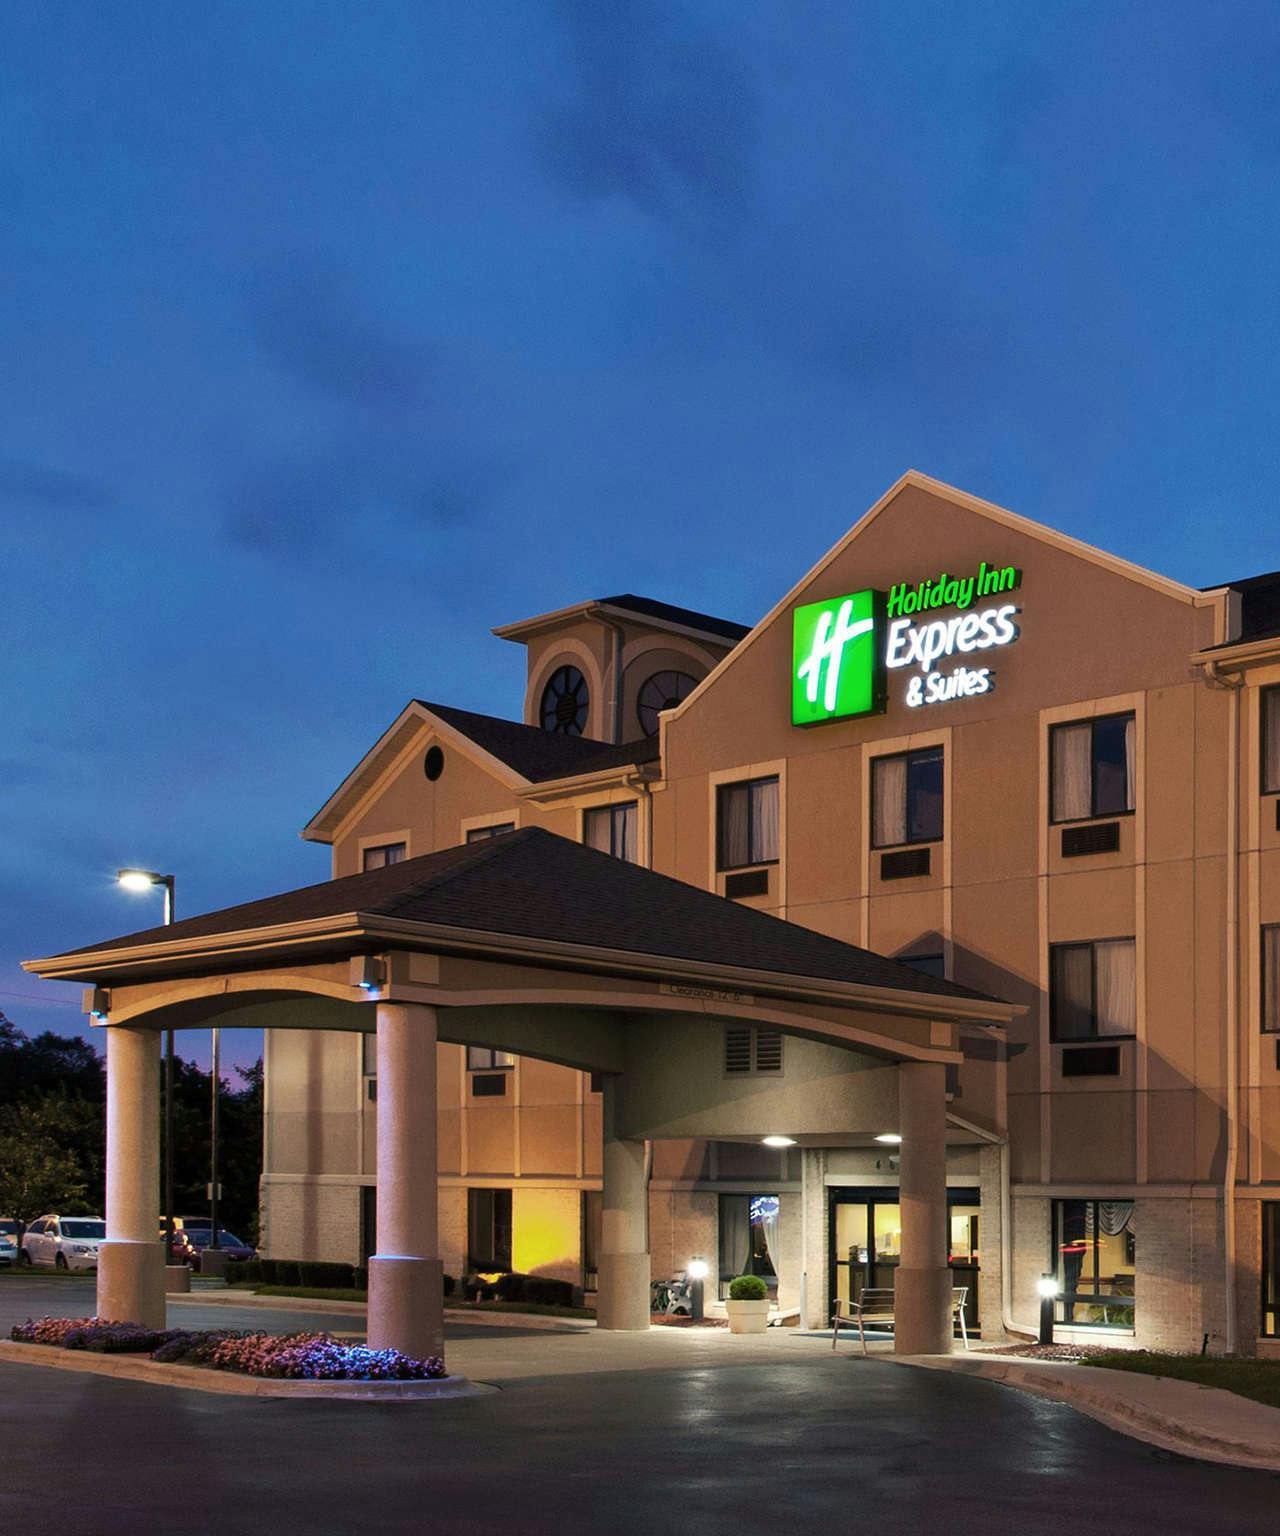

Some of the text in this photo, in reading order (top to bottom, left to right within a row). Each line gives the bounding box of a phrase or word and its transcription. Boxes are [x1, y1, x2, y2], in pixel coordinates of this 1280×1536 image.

[887, 562, 1016, 618] Holiday Inn
[885, 605, 1016, 672] Express
[906, 667, 989, 707] & Suites
